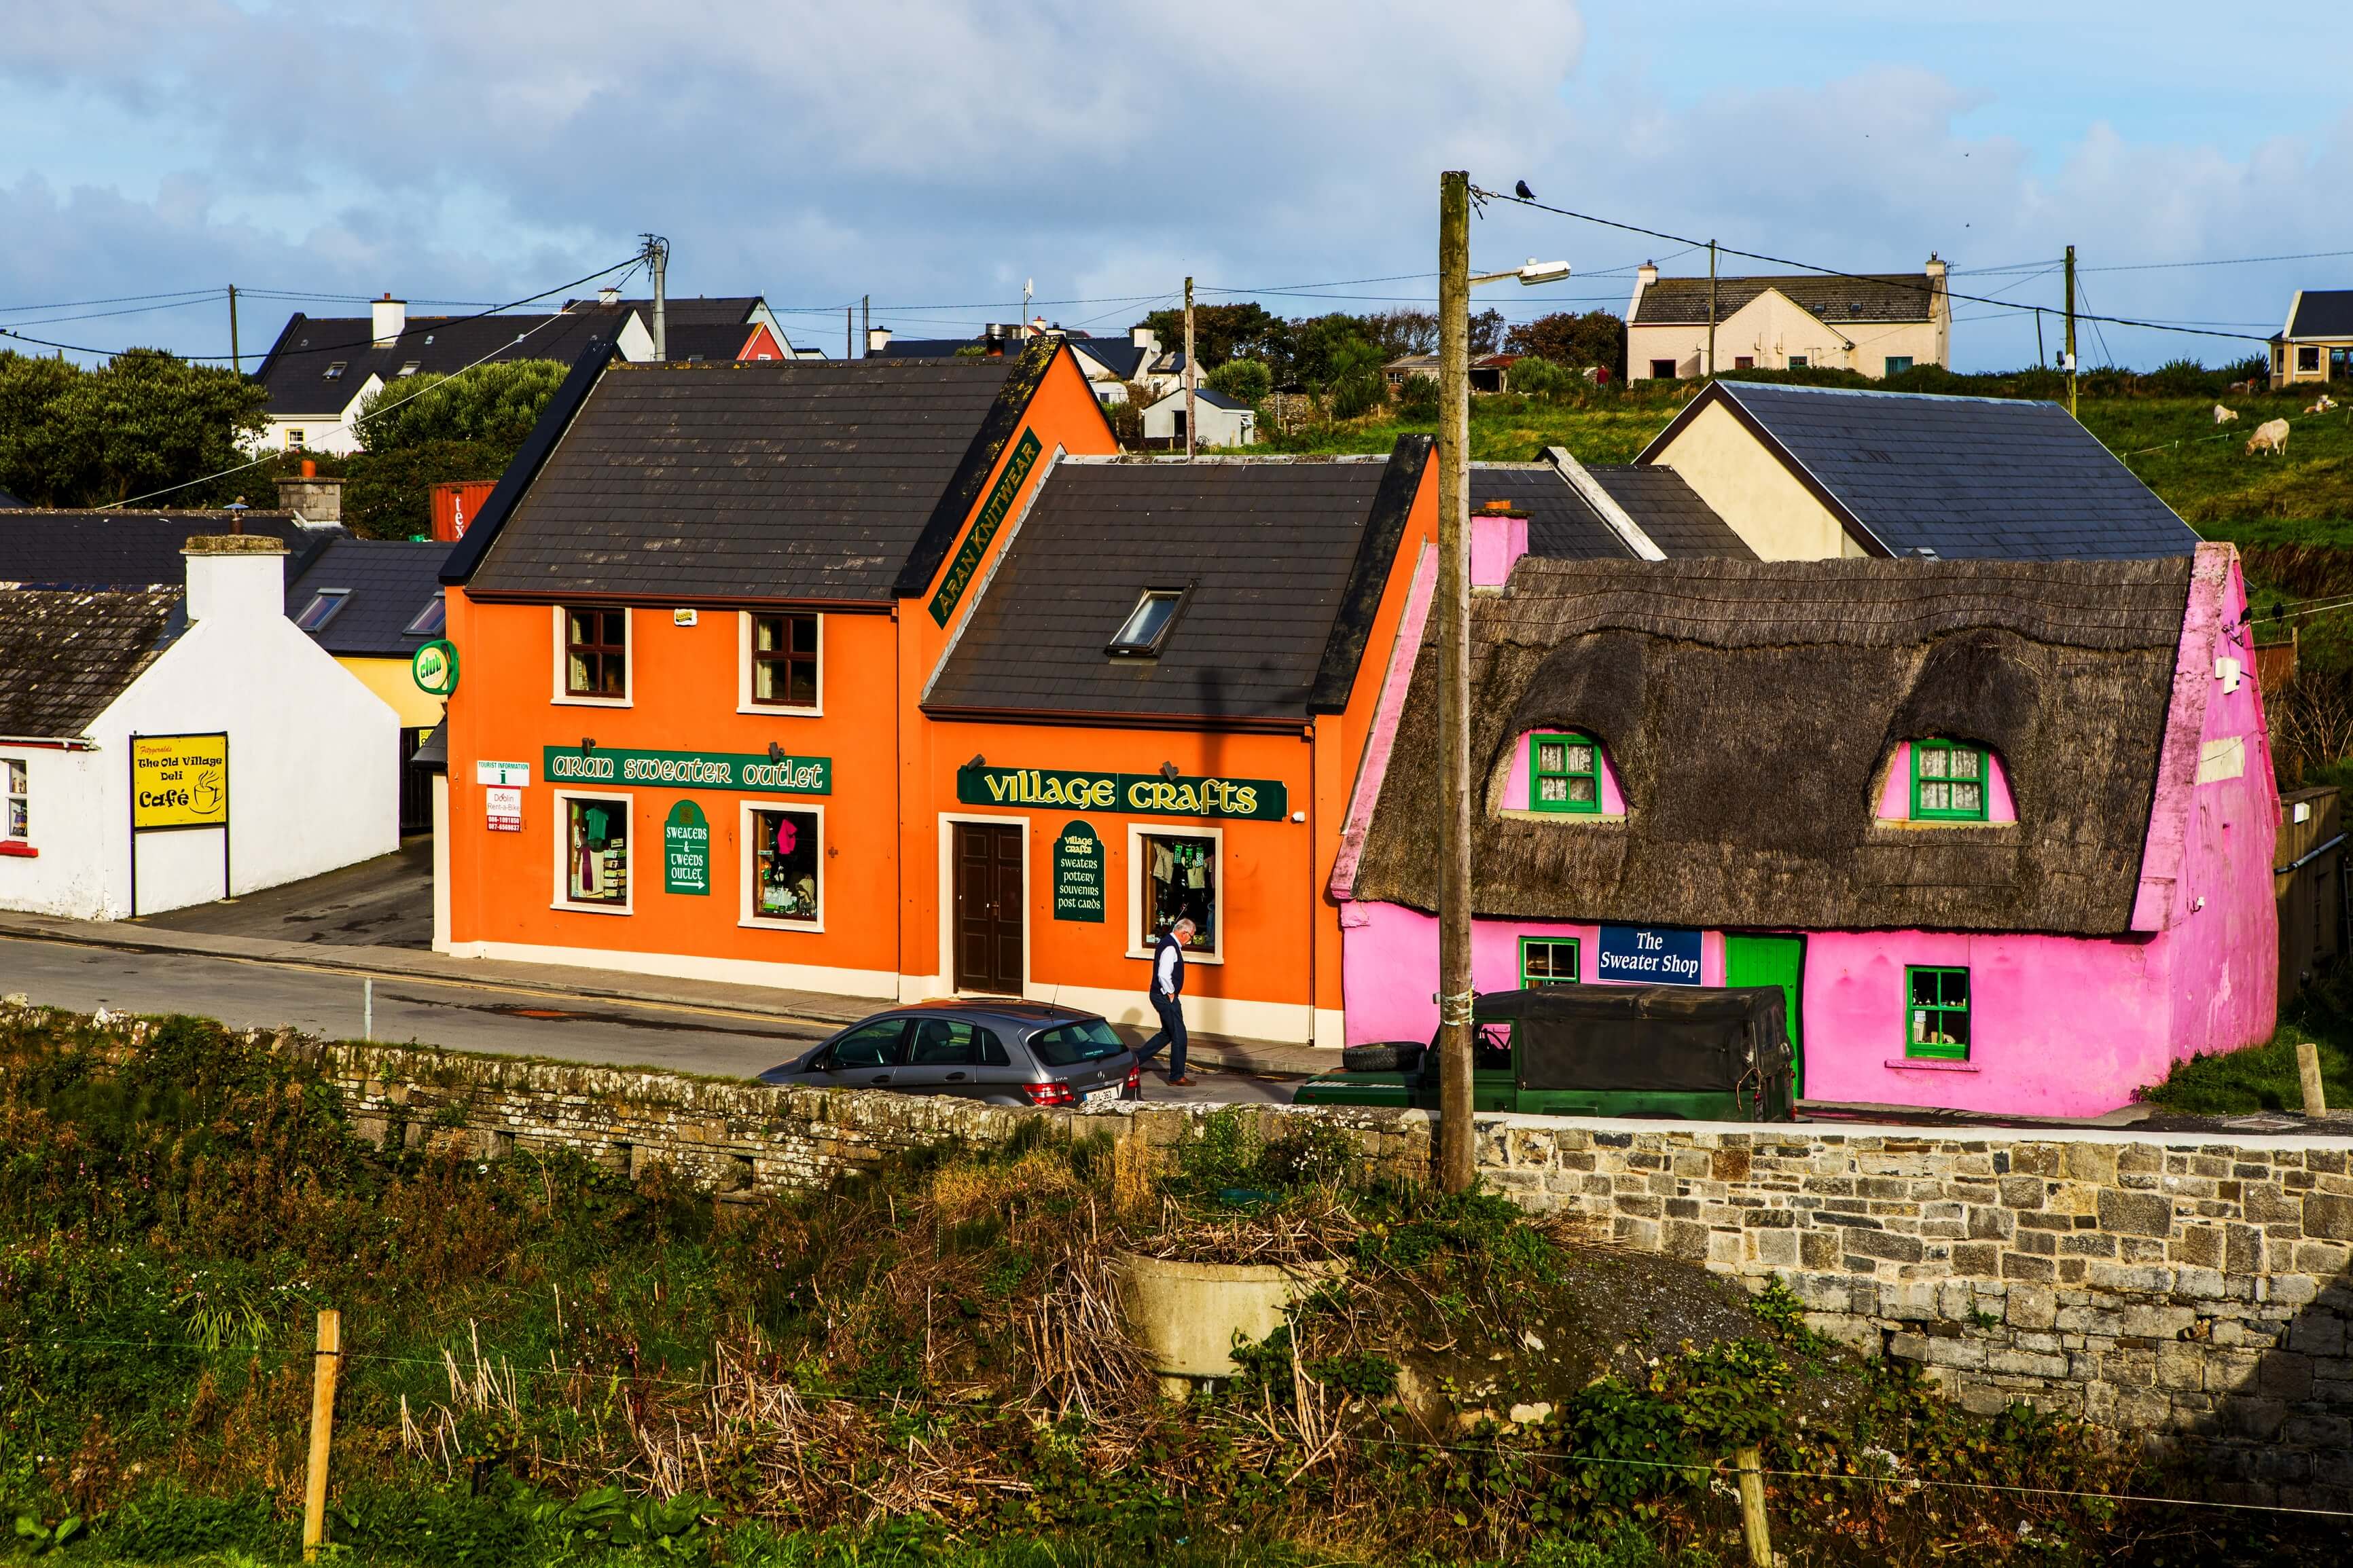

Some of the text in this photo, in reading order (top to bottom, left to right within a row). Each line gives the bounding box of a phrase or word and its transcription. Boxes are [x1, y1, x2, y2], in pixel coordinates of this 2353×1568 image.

[939, 441, 1037, 617] ARAN KNITWEAR
[139, 746, 173, 755] Fitzgeralds
[138, 756, 222, 768] The Old Village
[160, 771, 183, 780] Deli
[139, 788, 189, 807] Café
[666, 826, 707, 840] SWEATERS
[683, 841, 689, 852] &
[670, 854, 703, 867] TWEEDS
[671, 867, 702, 880] OUTLET
[1636, 932, 1663, 950] The
[1600, 951, 1698, 978] Sweater Shop
